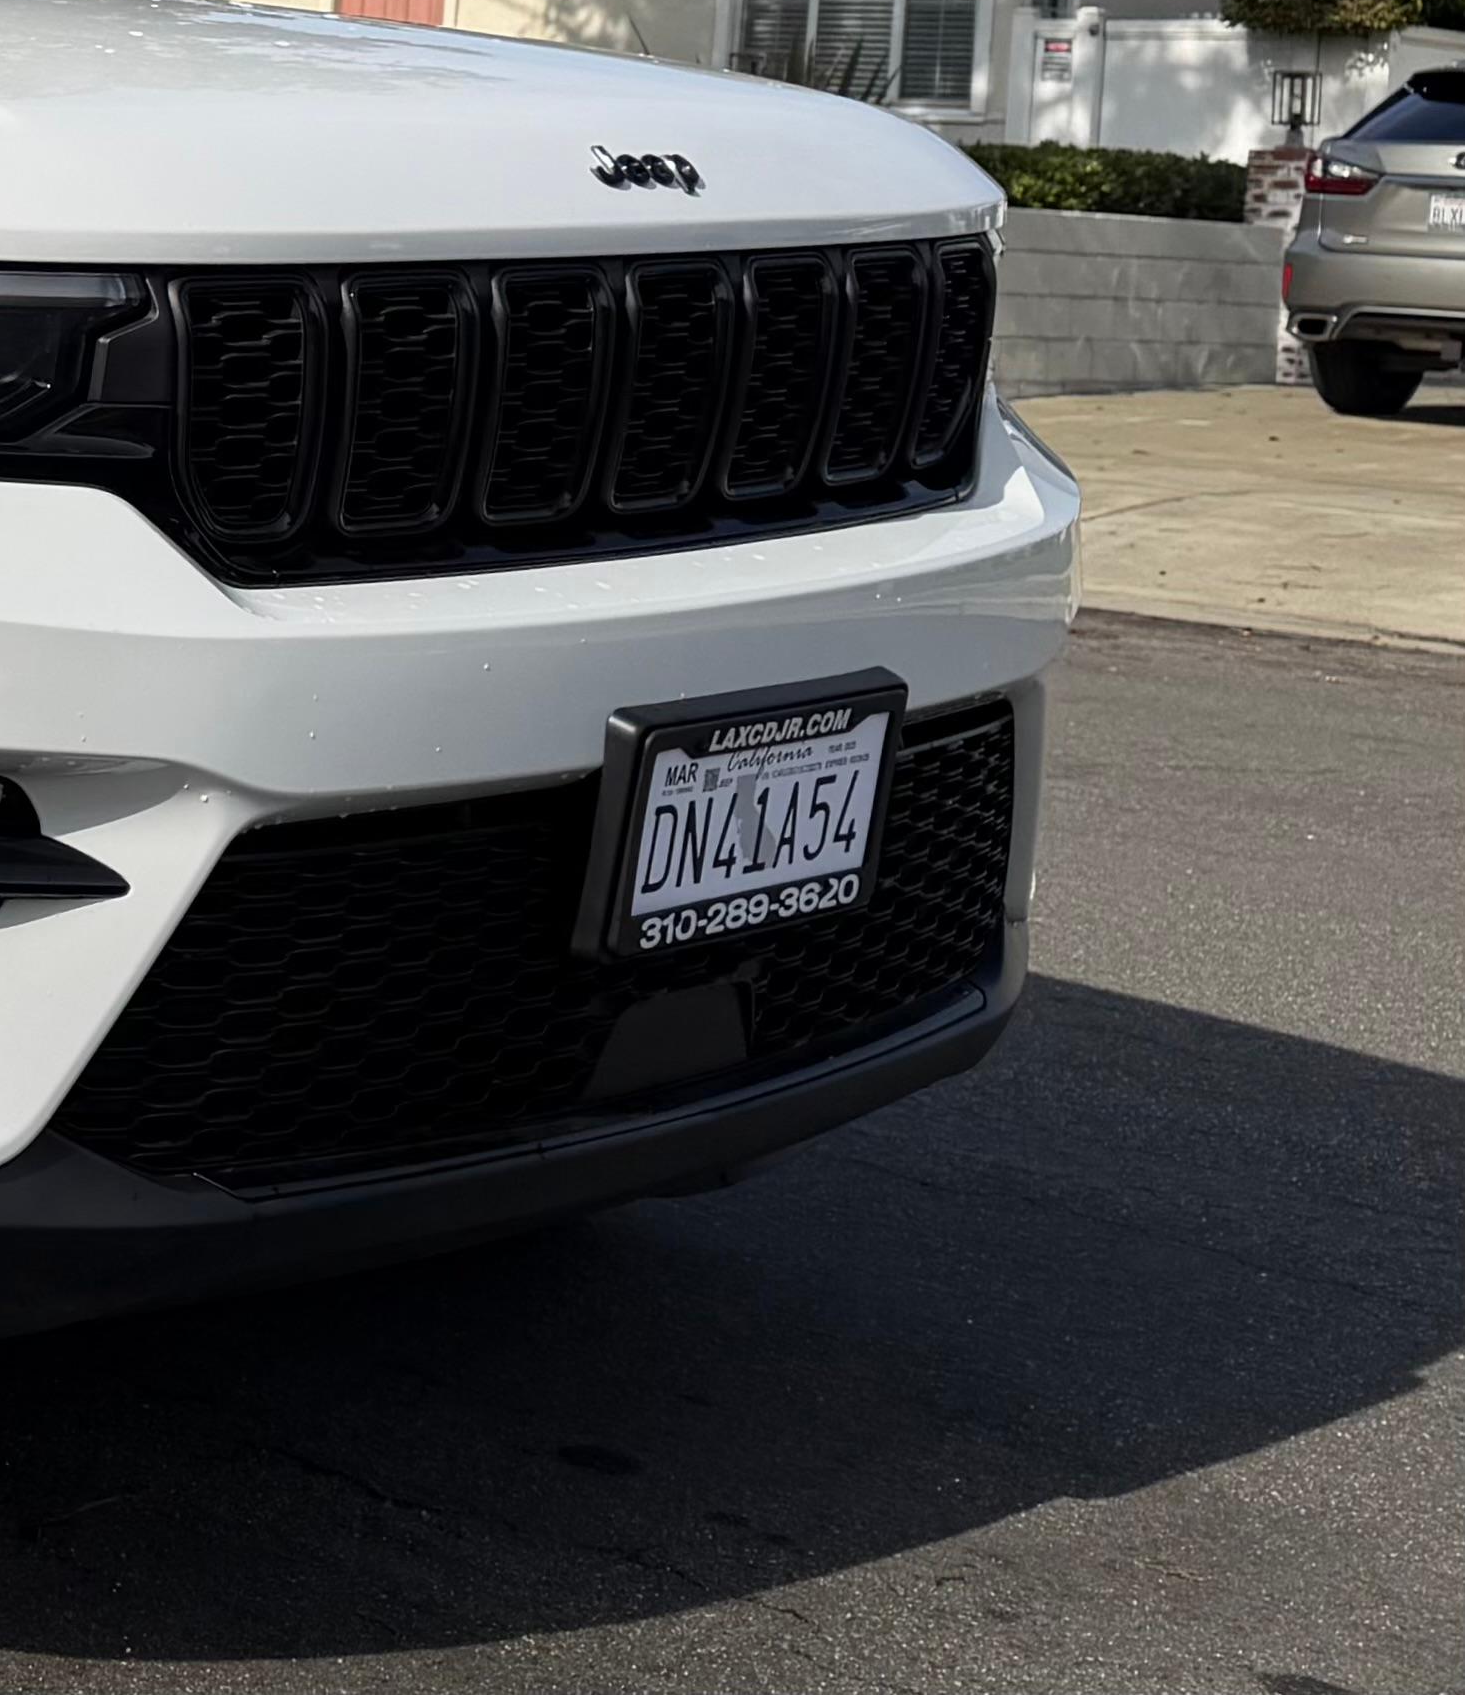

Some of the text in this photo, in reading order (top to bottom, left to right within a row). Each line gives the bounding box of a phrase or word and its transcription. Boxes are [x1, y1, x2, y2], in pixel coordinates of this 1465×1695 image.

[590, 145, 706, 197] Jeep
[708, 708, 852, 753] LAXCDJR.COM
[664, 761, 700, 788] MAR
[727, 744, 814, 781] California
[640, 769, 860, 895] DN41A54
[639, 873, 860, 951] 310-289-3620
